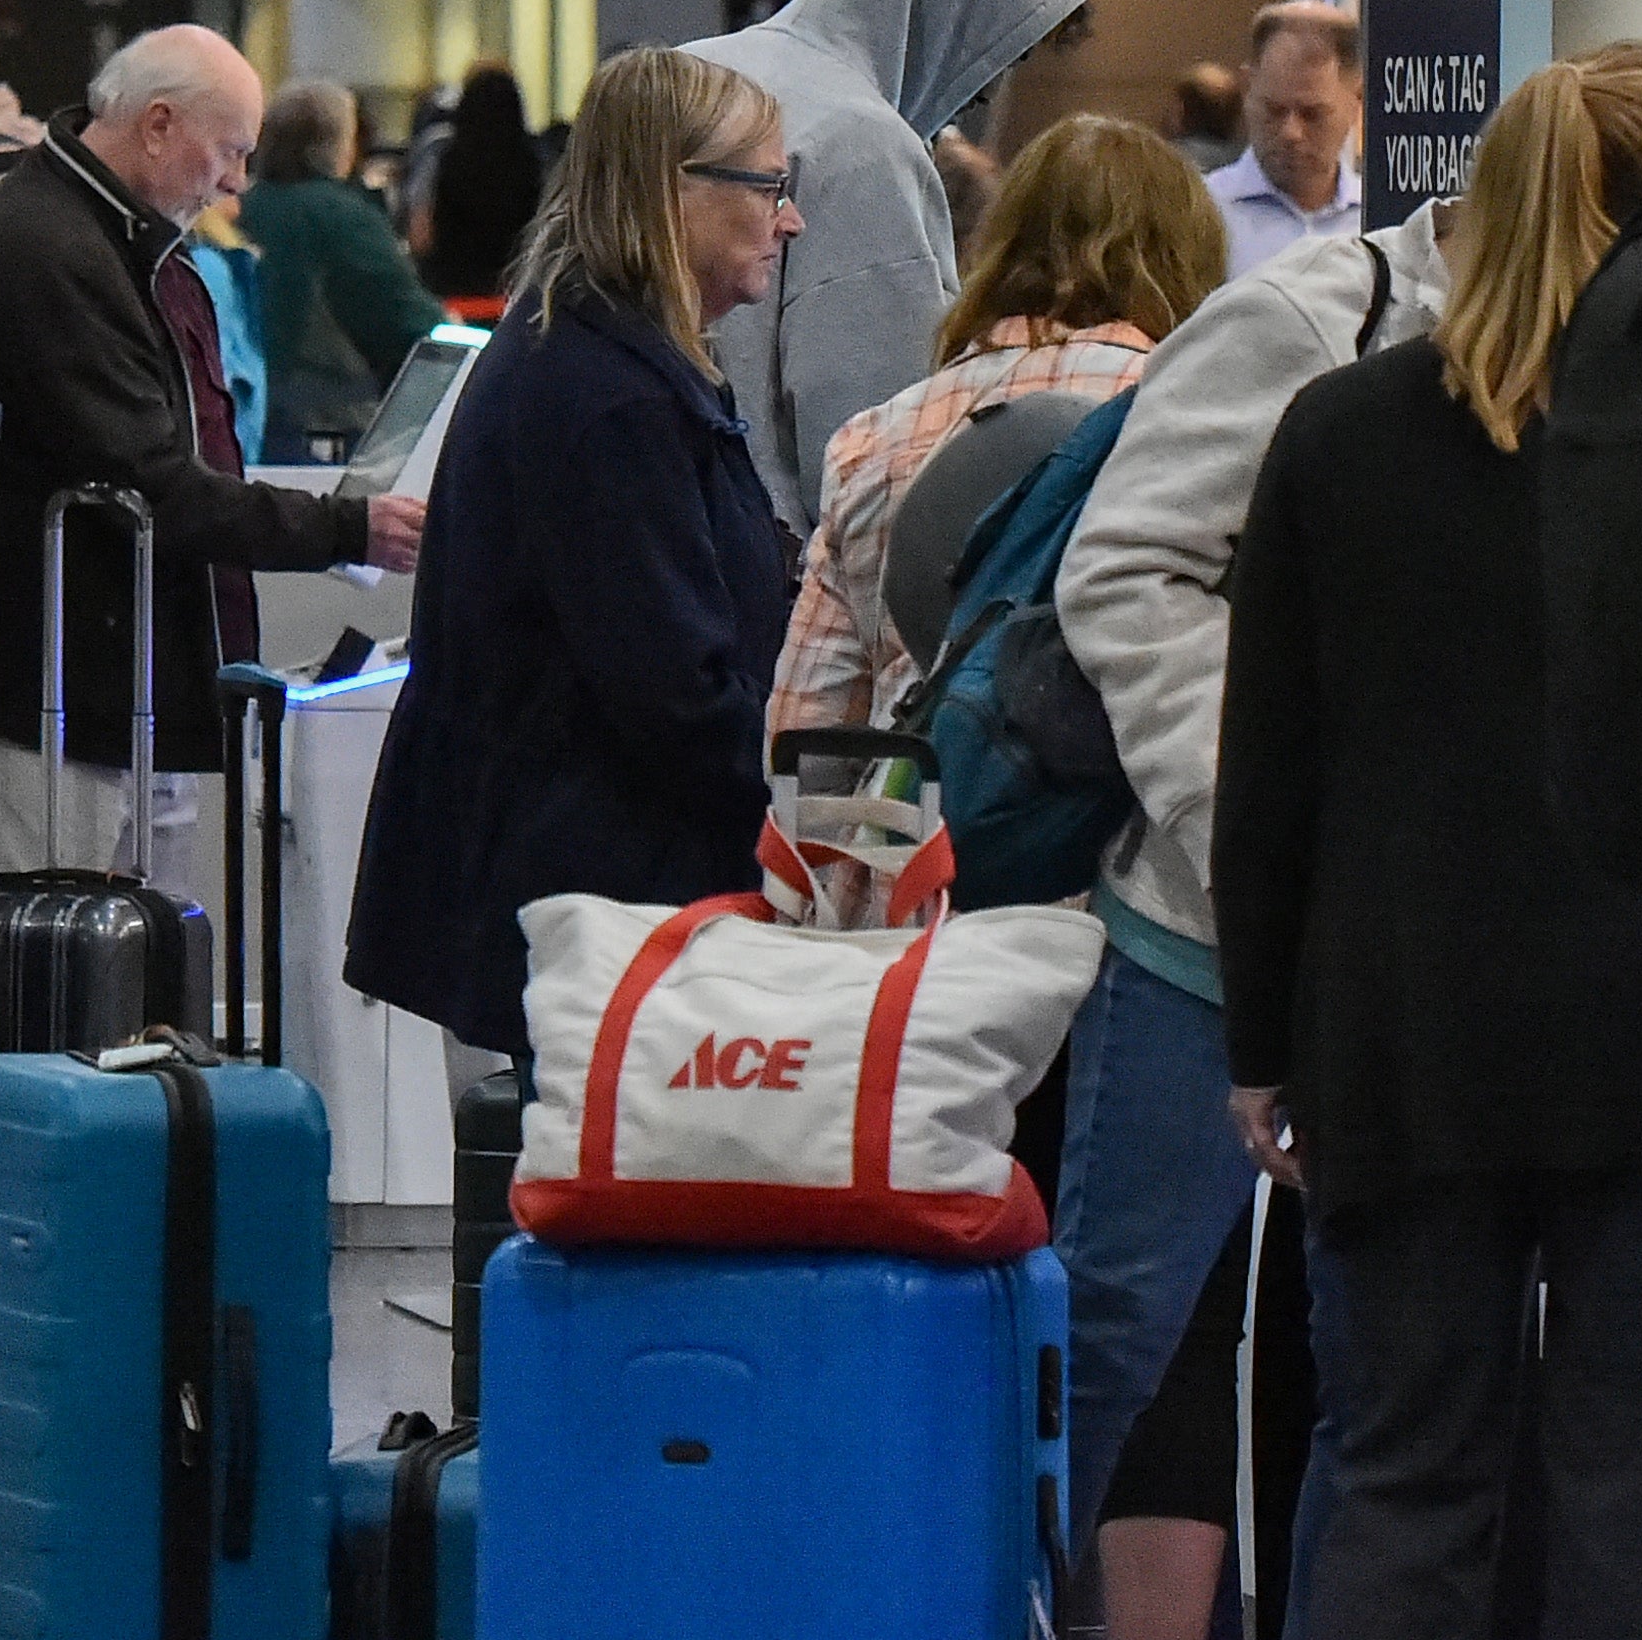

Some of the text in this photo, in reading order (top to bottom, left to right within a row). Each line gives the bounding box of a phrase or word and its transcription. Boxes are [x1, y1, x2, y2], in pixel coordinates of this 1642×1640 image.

[1383, 53, 1486, 114] SCAN & TAG
[1385, 134, 1434, 193] YOUR
[667, 1030, 813, 1091] ACE
